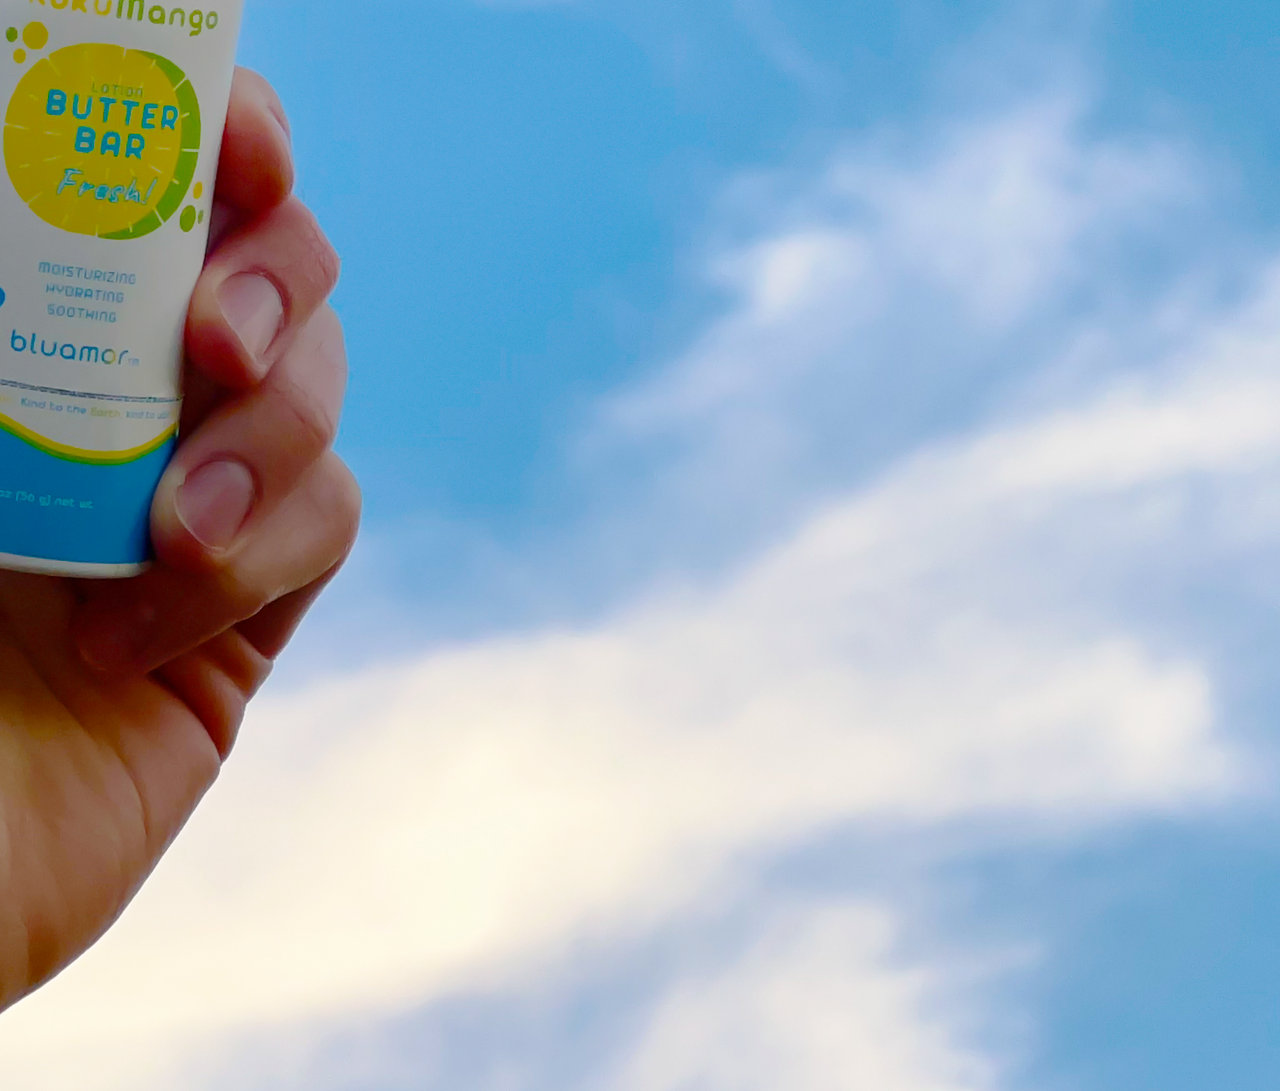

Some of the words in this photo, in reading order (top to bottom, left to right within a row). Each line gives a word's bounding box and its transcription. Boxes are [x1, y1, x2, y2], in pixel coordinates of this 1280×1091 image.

[46, 89, 179, 131] BUTTER
[74, 126, 145, 160] BAR
[56, 168, 158, 205] Fresh!
[38, 261, 136, 285] MOISTURIZING
[45, 283, 124, 304] HYDRATING
[47, 303, 117, 323] SOOTHING
[10, 329, 129, 365] bluamor
